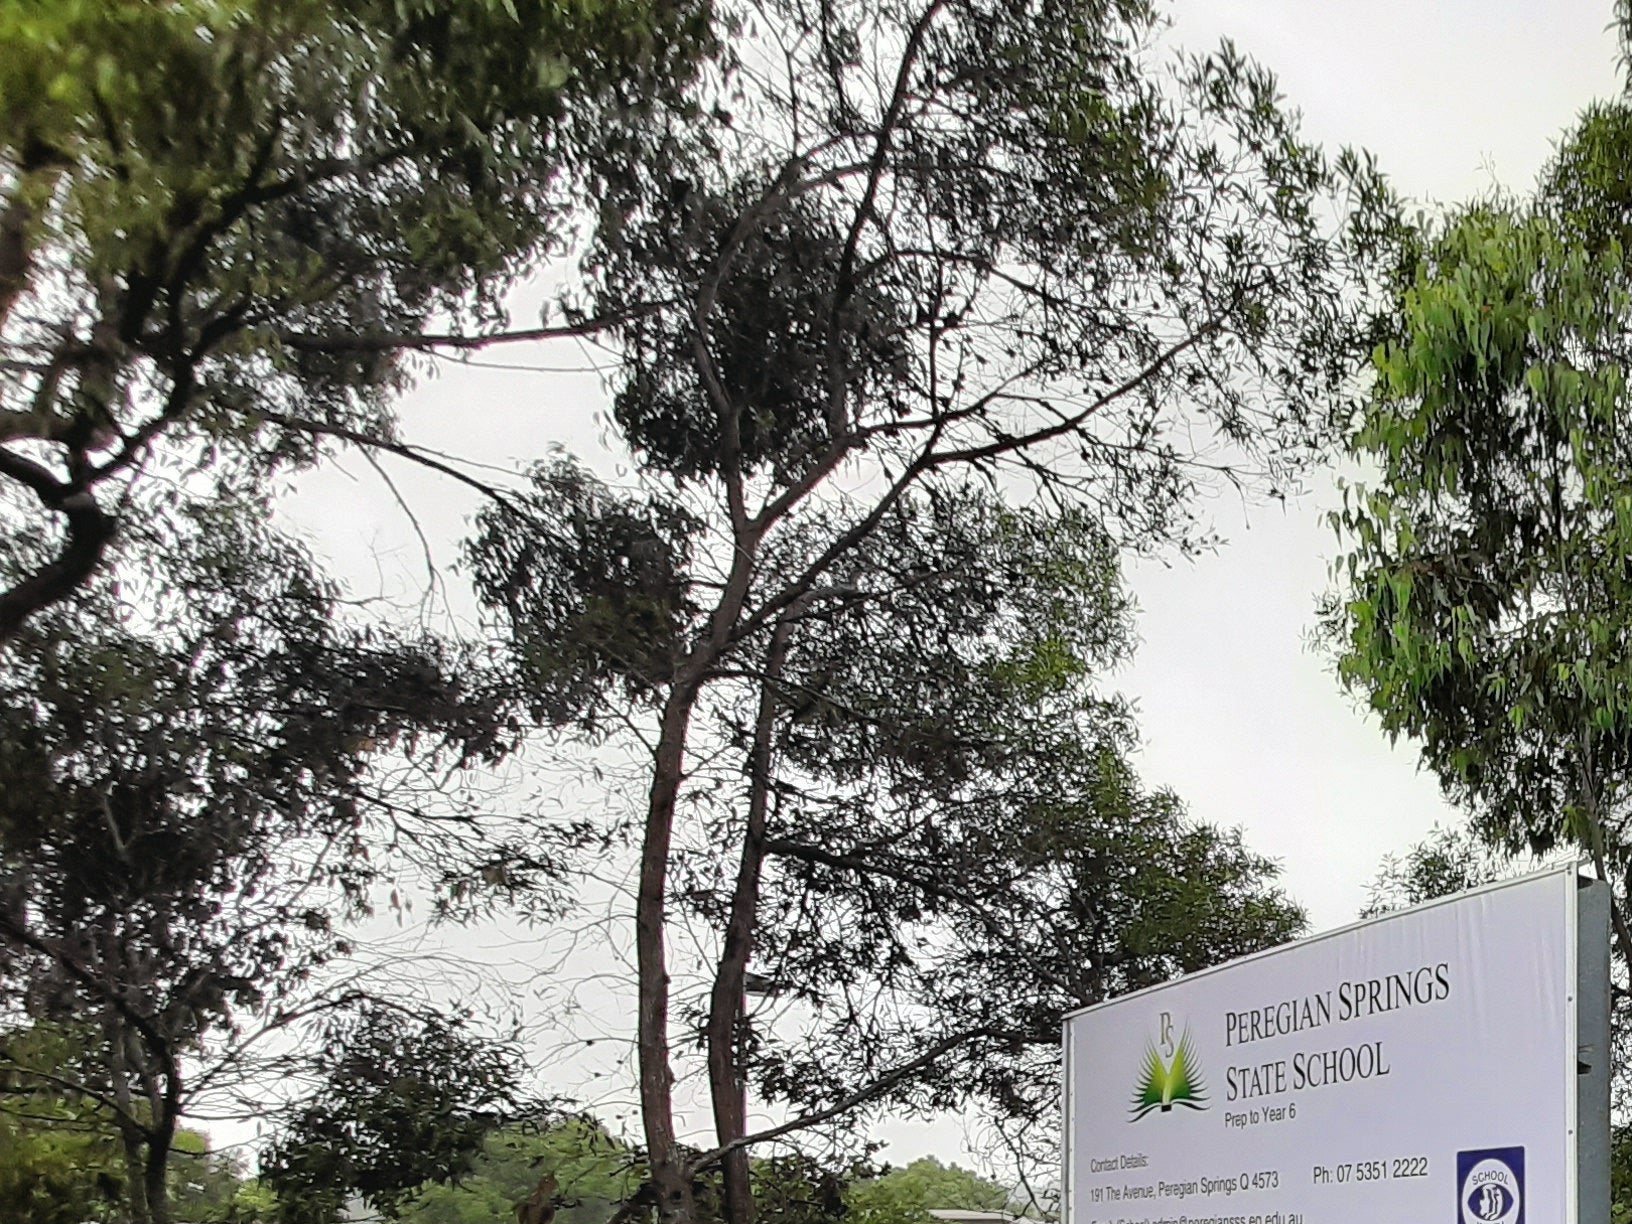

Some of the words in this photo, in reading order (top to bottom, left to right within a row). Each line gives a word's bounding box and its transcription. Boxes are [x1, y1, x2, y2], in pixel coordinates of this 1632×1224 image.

[1225, 990, 1332, 1047] PEREGIAN
[1338, 962, 1450, 1021] SPRINGS
[1226, 1059, 1287, 1101] STATE
[1293, 1041, 1390, 1090] SCHOOL
[1225, 1110, 1247, 1129] Prep
[1250, 1108, 1259, 1124] to
[1262, 1105, 1286, 1122] Year
[1289, 1102, 1296, 1119] 6
[1090, 1157, 1119, 1173] Contact
[1120, 1154, 1148, 1171] Details:
[1313, 1166, 1334, 1184] Ph:
[1336, 1163, 1352, 1183] 07
[1356, 1161, 1387, 1182] 5351
[1393, 1156, 1429, 1180] 2222
[1472, 1170, 1509, 1185] SCHOOL
[1090, 1187, 1104, 1202] 191
[1106, 1185, 1121, 1201] The
[1123, 1183, 1156, 1201] Avenue,
[1158, 1178, 1198, 1200] Peregian
[1200, 1175, 1237, 1197] Springs
[1239, 1173, 1249, 1191] Q
[1252, 1170, 1279, 1190] 4573
